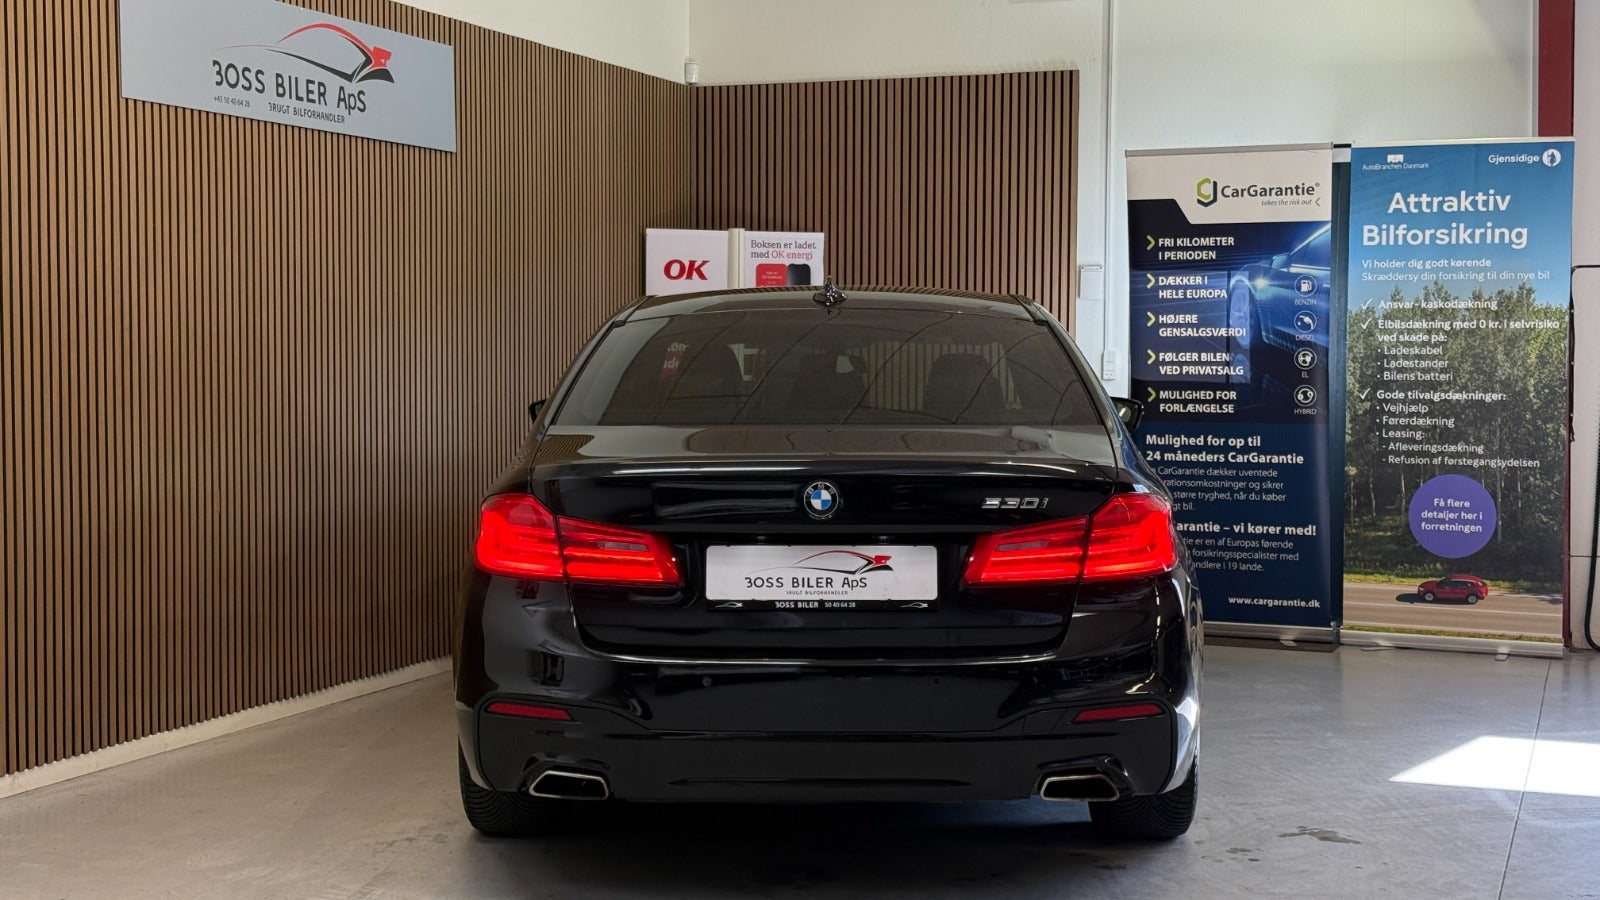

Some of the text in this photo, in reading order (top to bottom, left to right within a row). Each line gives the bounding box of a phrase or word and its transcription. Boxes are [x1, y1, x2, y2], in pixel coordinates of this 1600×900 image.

[276, 72, 327, 106] BILER
[337, 86, 366, 115] ApS
[293, 106, 345, 124] BILFORHANDLER
[1488, 154, 1540, 164] Gjensidige
[1388, 189, 1511, 213] Attraktiv
[1362, 222, 1528, 249] Bilforsikring
[751, 240, 781, 248] Boksen
[795, 241, 816, 249] ladet
[1159, 237, 1234, 247] FRI KILOMETER
[751, 250, 813, 261] med OK energi
[1165, 250, 1216, 260] PERIODEN
[663, 259, 710, 280] OK
[1362, 259, 1491, 270] Vi holder dig godt kørende
[1159, 277, 1202, 286] DÆKKER
[1362, 271, 1550, 282] Skræddersy din forsikring til din nye bil
[1159, 289, 1227, 298] HELE EUROPA
[1421, 300, 1498, 310] kaskodækning
[1159, 314, 1198, 324] HØJERE
[1378, 320, 1450, 331] Elbilsdækning
[1453, 320, 1477, 329] med
[1489, 320, 1501, 329] kr.
[1509, 320, 1559, 329] selvrisiko
[1159, 328, 1246, 337] GENSALGSVÆRDI
[1378, 332, 1447, 343] ved skade på:
[1384, 346, 1443, 355] Ladeskabel
[1159, 352, 1230, 362] FØLGER BILEN
[1384, 359, 1449, 368] Ladestander
[1159, 366, 1244, 375] VED PRIVATSALG
[1383, 372, 1453, 380] Bilens batteri
[1160, 391, 1237, 400] MULIGHED FOR
[1376, 390, 1506, 401] Gode tilvalgsdækninger:
[1160, 403, 1234, 413] FORLÆNGELSE
[1383, 404, 1428, 414] Vejhjælp
[1383, 416, 1454, 427] Førerdækning
[1383, 430, 1425, 440] Leasing:
[1146, 434, 1261, 448] Mulighed for op til
[1388, 443, 1484, 454] Afleveringsdækning
[1146, 451, 1304, 464] 24 måneders CarGarantie
[1388, 456, 1540, 468] Refusion af førstegangsydelsen
[1158, 466, 1204, 475] CarGarantie
[1207, 468, 1236, 476] dækker
[1239, 468, 1278, 477] uventede
[1249, 482, 1260, 490] og
[1262, 481, 1284, 489] sikrer
[1198, 491, 1232, 501] tryghed,
[1234, 491, 1247, 500] når
[1249, 492, 1260, 500] du
[1262, 493, 1286, 501] køber
[1183, 502, 1194, 510] bil.
[1434, 498, 1470, 508] Få flere
[1421, 510, 1459, 520] detaljer
[1461, 511, 1477, 520] her
[1233, 523, 1244, 533] vi
[1248, 523, 1281, 534] kører
[1285, 525, 1316, 535] med!
[1421, 523, 1482, 532] forretningen
[1227, 538, 1259, 548] Europas
[1262, 540, 1293, 548] førende
[1192, 548, 1277, 560] forsikringsspecialister
[1240, 562, 1264, 571] lande.
[792, 577, 833, 588] BILER
[842, 577, 868, 590] ApS
[1228, 596, 1320, 608] www.cargarantie.dk
